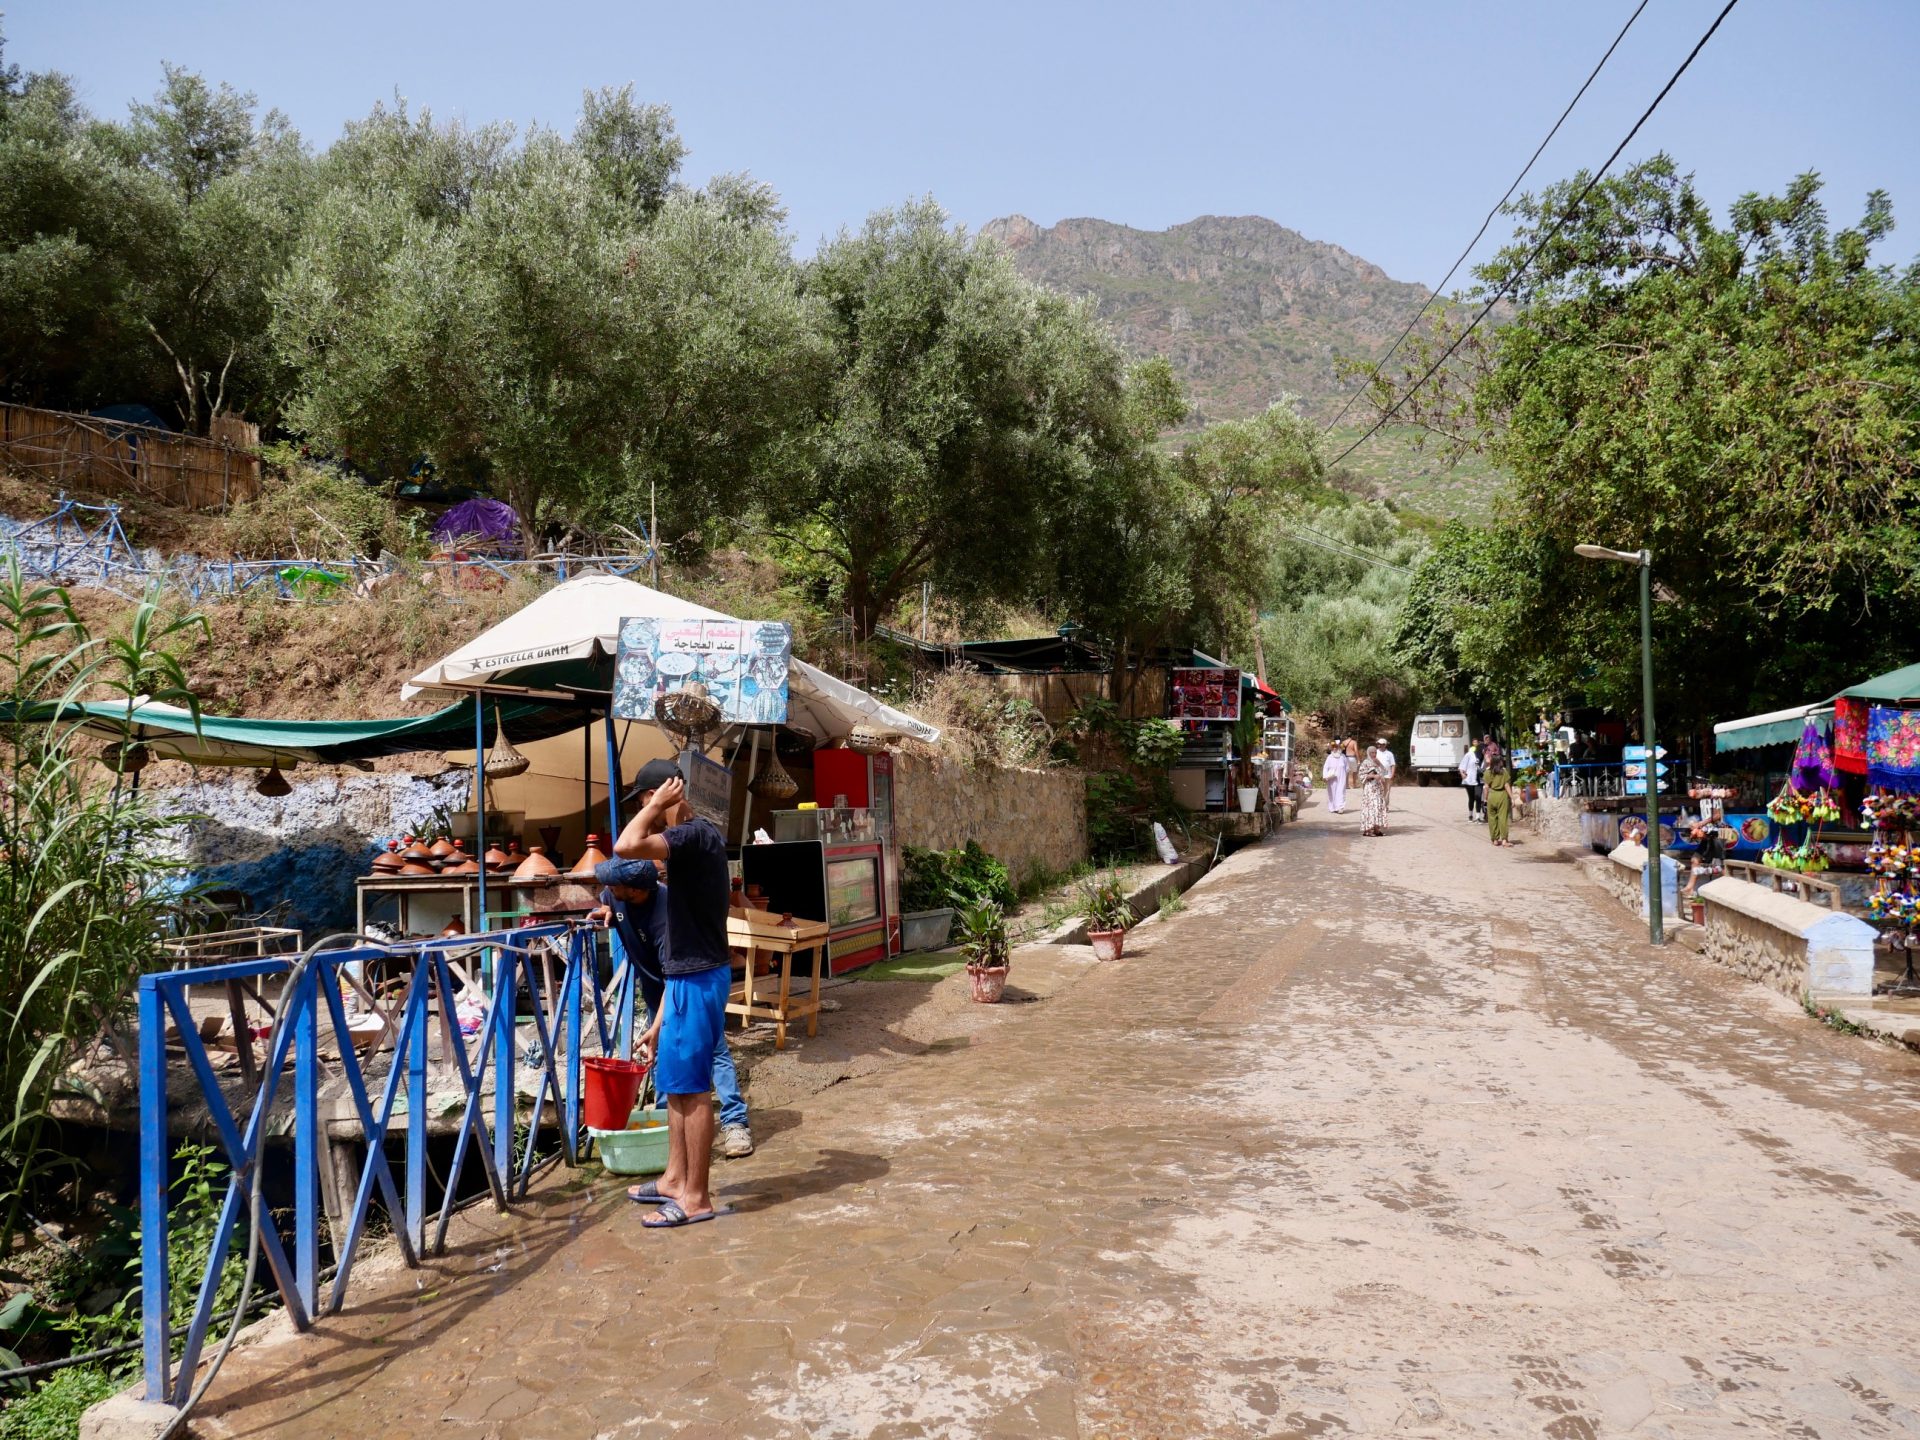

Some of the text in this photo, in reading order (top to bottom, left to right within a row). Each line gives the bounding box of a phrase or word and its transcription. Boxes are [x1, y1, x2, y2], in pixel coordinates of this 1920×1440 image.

[665, 624, 746, 640] مطعم شعبي
[716, 640, 735, 651] عند
[485, 653, 533, 668] ESTRELLA
